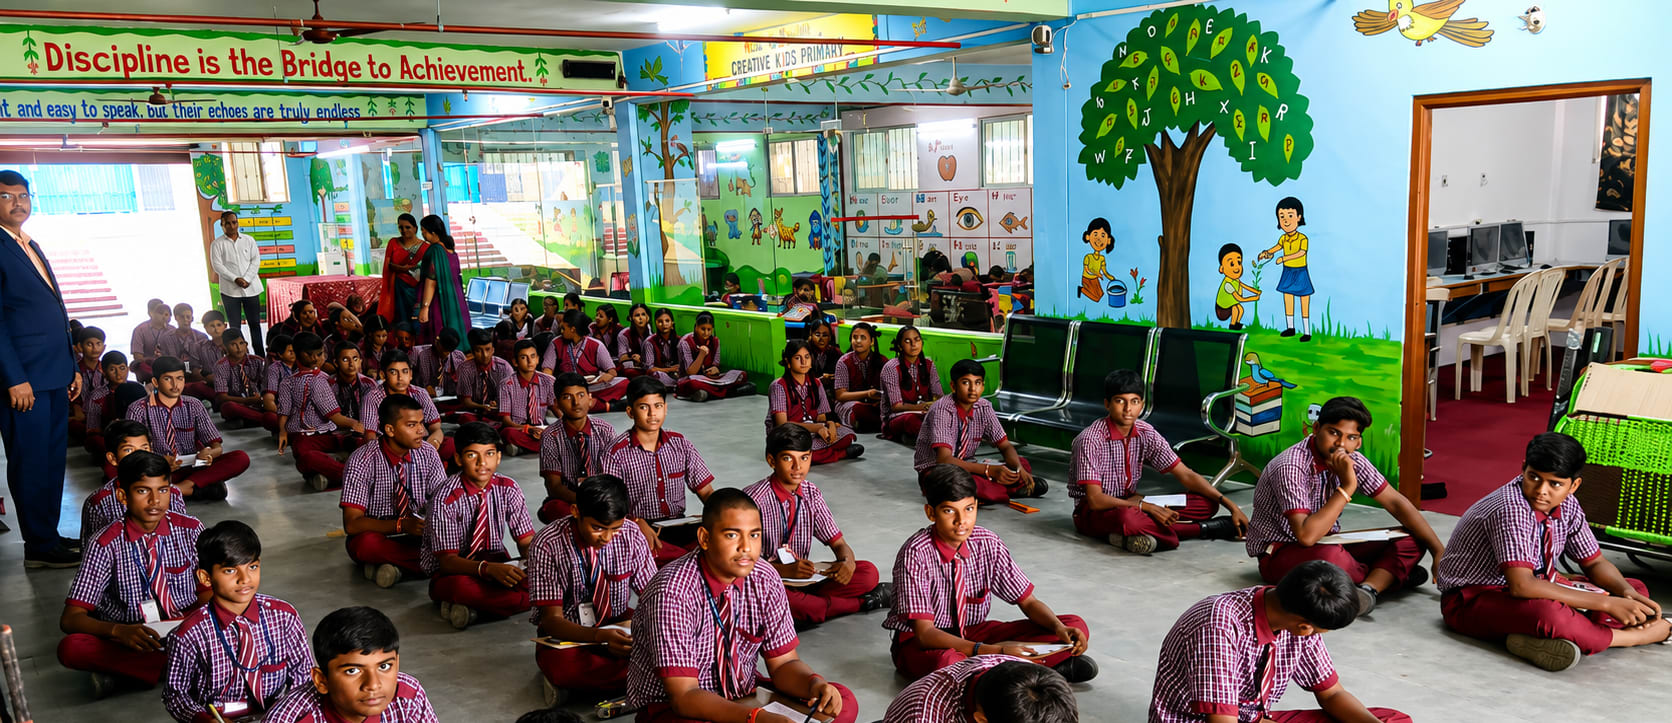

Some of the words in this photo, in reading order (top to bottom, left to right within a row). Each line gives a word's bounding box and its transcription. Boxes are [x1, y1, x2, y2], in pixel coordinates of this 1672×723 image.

[1205, 18, 1214, 34] E
[731, 55, 771, 76] CREATIVE
[775, 50, 797, 68] KIDS
[801, 41, 844, 66] PRIMARY
[1119, 45, 1127, 58] N
[1260, 46, 1272, 64] K
[44, 42, 190, 79] Discipline
[197, 48, 220, 75] is
[229, 48, 273, 76] the
[280, 49, 362, 84] Bridge
[367, 53, 392, 79] to
[400, 54, 532, 82] Achievement.
[1185, 91, 1195, 106] H
[1219, 99, 1230, 114] X
[17, 99, 42, 118] and
[47, 104, 76, 124] easy
[81, 99, 98, 118] to
[172, 101, 203, 118] their
[208, 101, 248, 118] echoes
[253, 106, 274, 119] are
[279, 101, 310, 124] truly
[316, 103, 361, 119] endless
[1141, 108, 1151, 126] J
[1275, 103, 1289, 121] R
[1094, 149, 1106, 164] W
[1249, 141, 1256, 160] I
